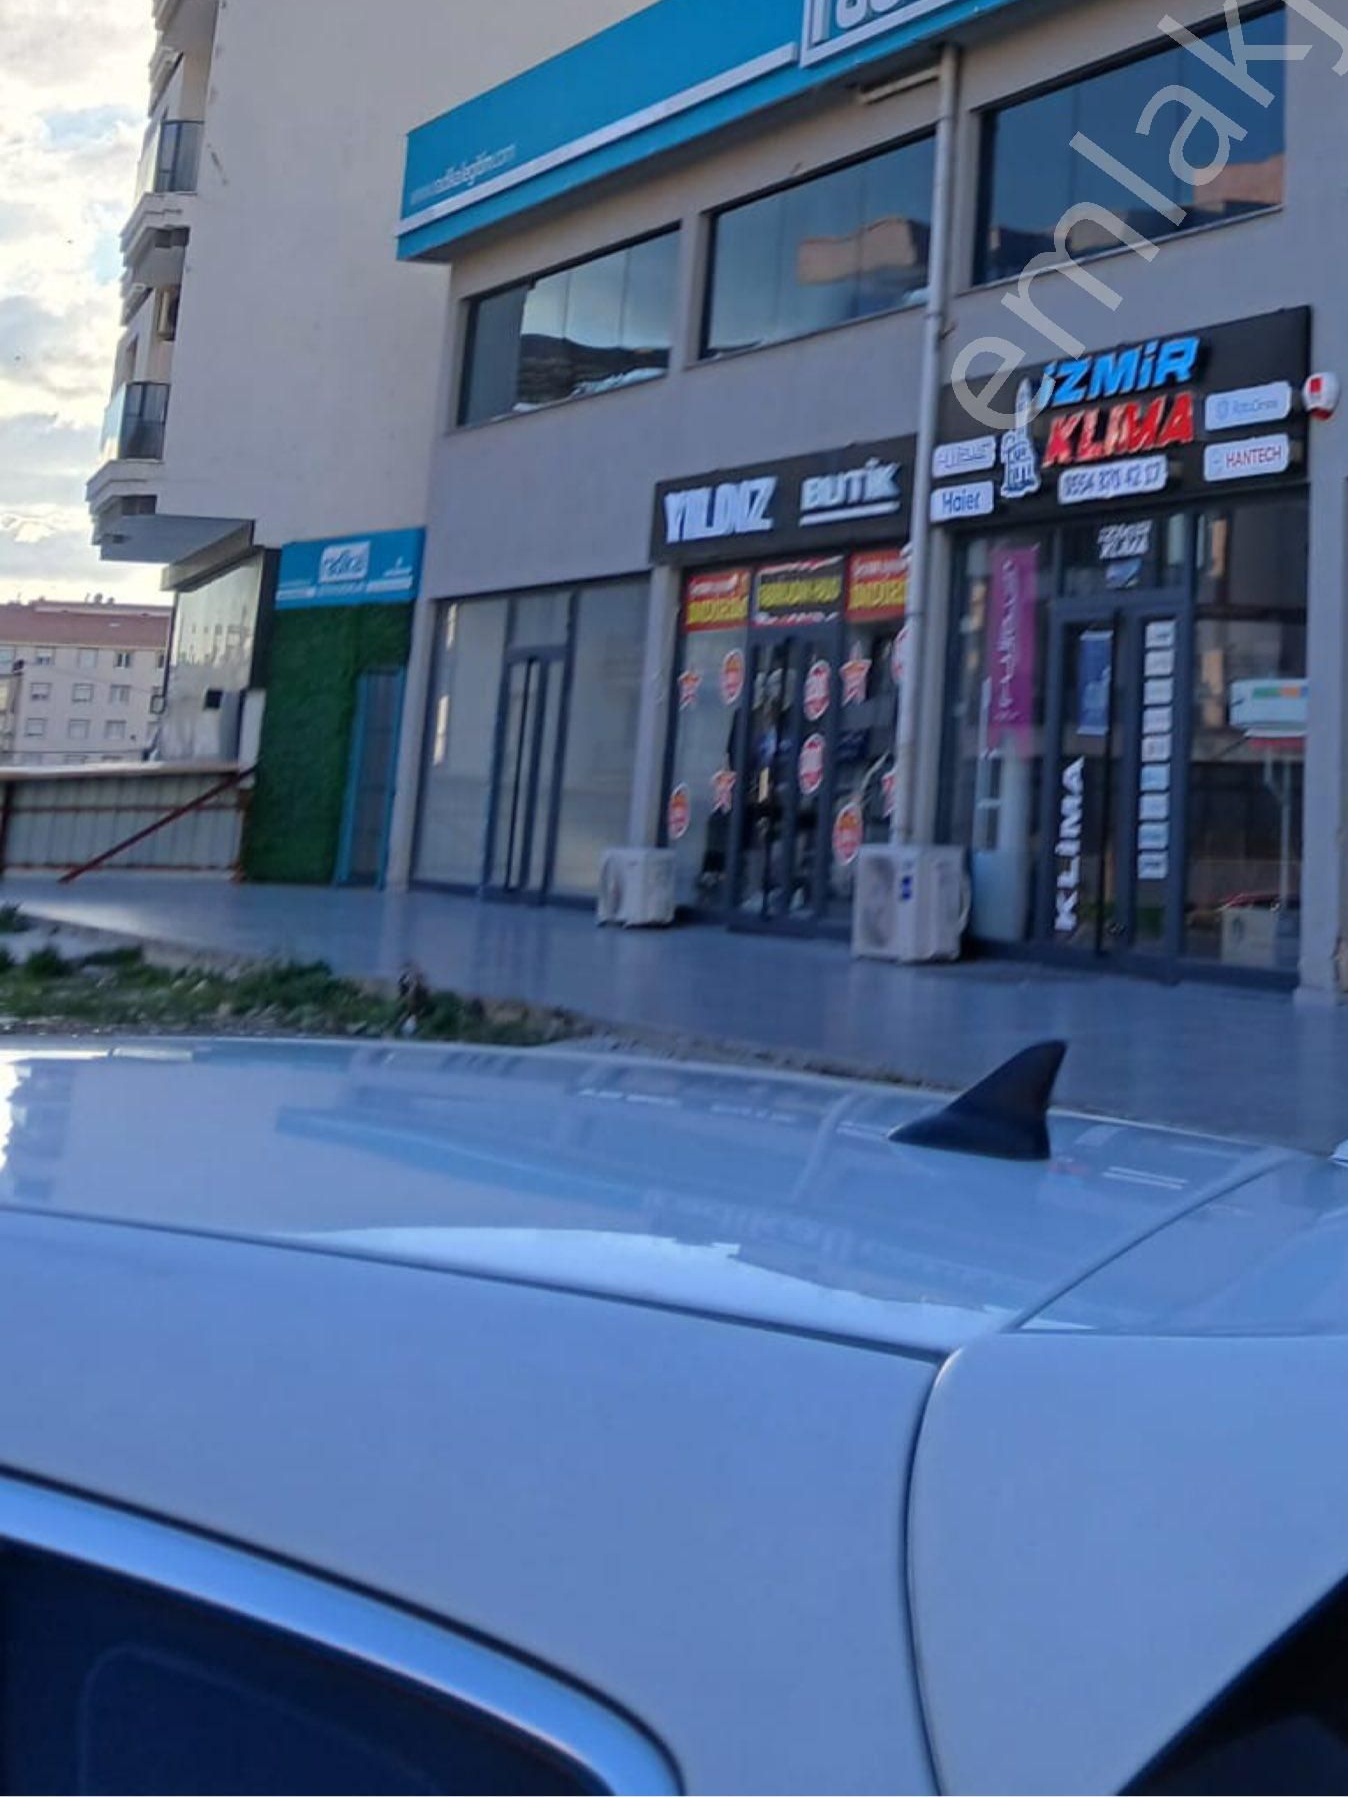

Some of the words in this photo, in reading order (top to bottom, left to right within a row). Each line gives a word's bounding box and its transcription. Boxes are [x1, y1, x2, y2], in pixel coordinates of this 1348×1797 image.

[1225, 445, 1283, 468] HANTECH
[800, 458, 901, 512] BUTİK
[942, 488, 981, 514] Haier
[664, 475, 778, 544] YILDIZ
